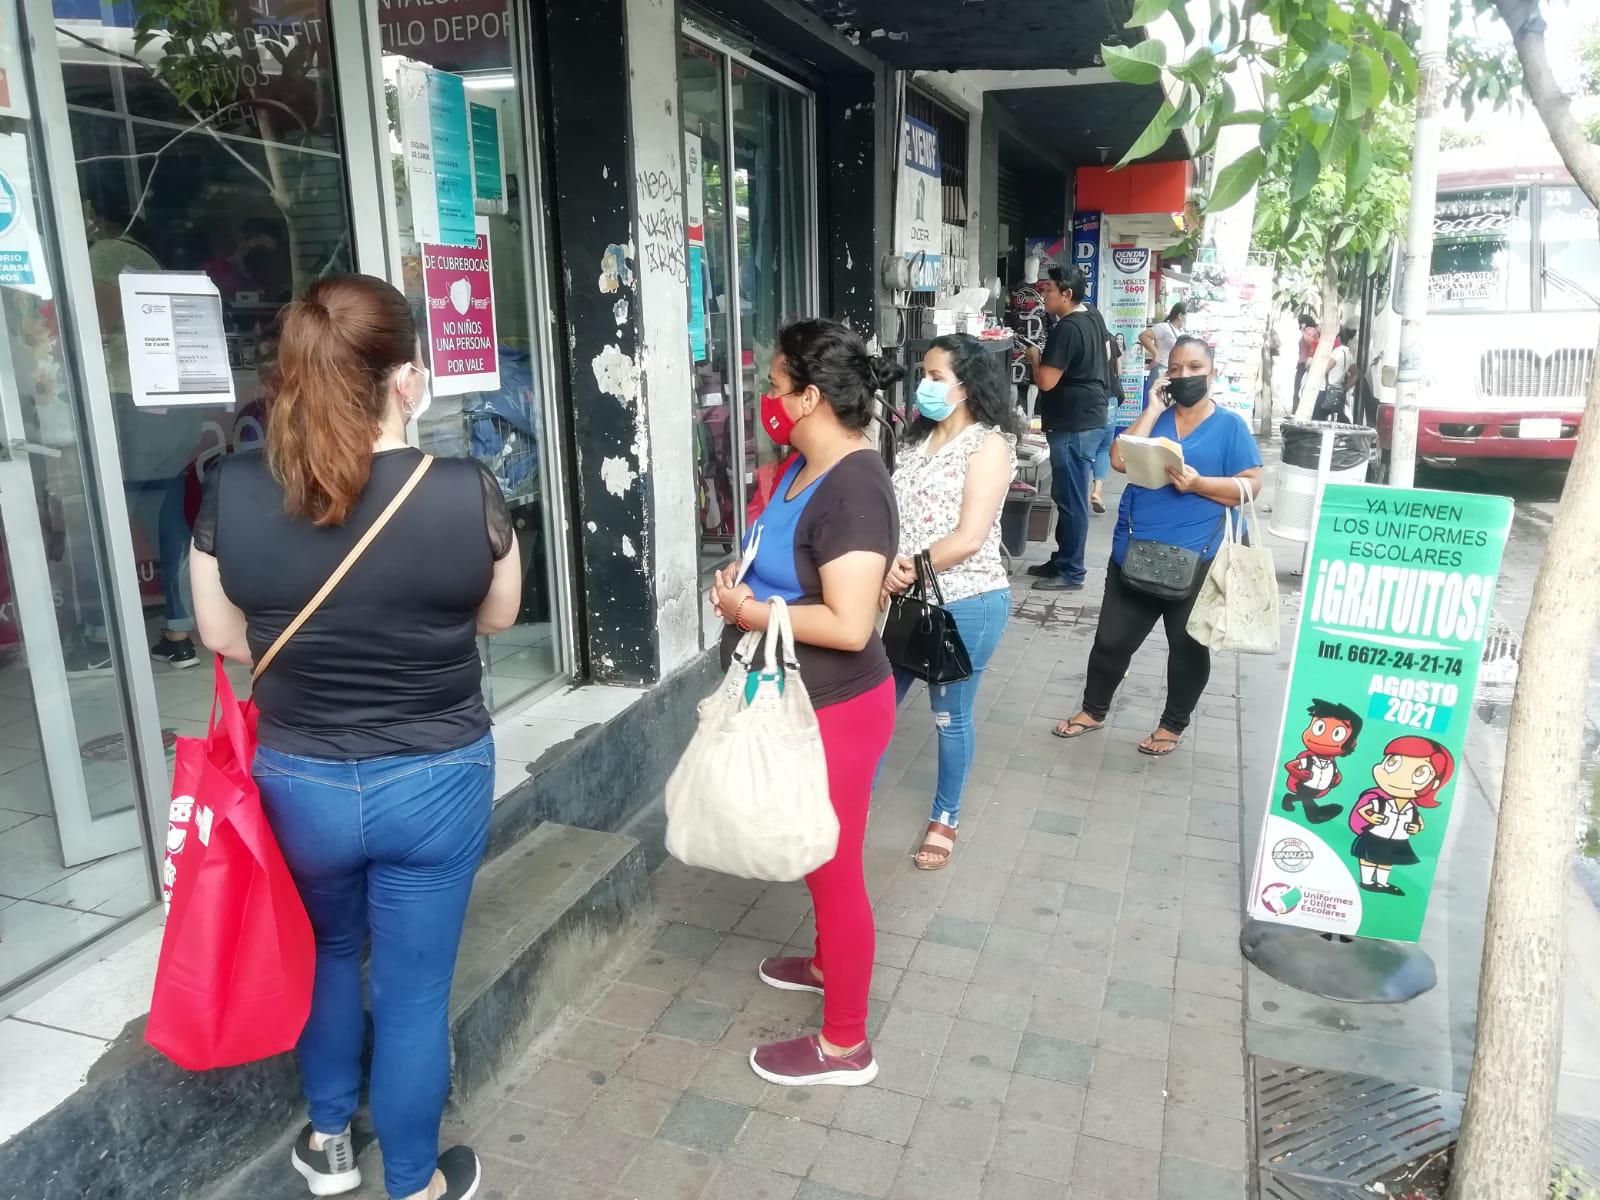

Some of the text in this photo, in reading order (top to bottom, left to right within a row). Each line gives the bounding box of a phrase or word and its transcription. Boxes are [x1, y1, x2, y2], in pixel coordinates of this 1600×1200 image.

[289, 19, 322, 48] FIT
[425, 255, 489, 273] DE CUBREBOCAS
[1116, 250, 1146, 260] DENTAL
[1125, 285, 1145, 294] $699
[443, 318, 483, 335] NO NIÑOS
[436, 336, 492, 352] UNA PERSONA
[448, 357, 484, 373] POR VALE
[1366, 498, 1463, 522] YA VIENEN
[1333, 517, 1488, 547] LOS UNIFORMES
[1349, 541, 1463, 567] ESCOLARES
[1310, 559, 1494, 642] ¡GRATUITOS!
[1317, 640, 1463, 676] Inf. 6672-24-21-74
[1367, 674, 1460, 707] AGOSTO
[1384, 697, 1438, 731] 2021
[1273, 851, 1313, 859] SINALOA
[1303, 891, 1354, 906] Uniformes
[1301, 904, 1347, 918] Escolares
